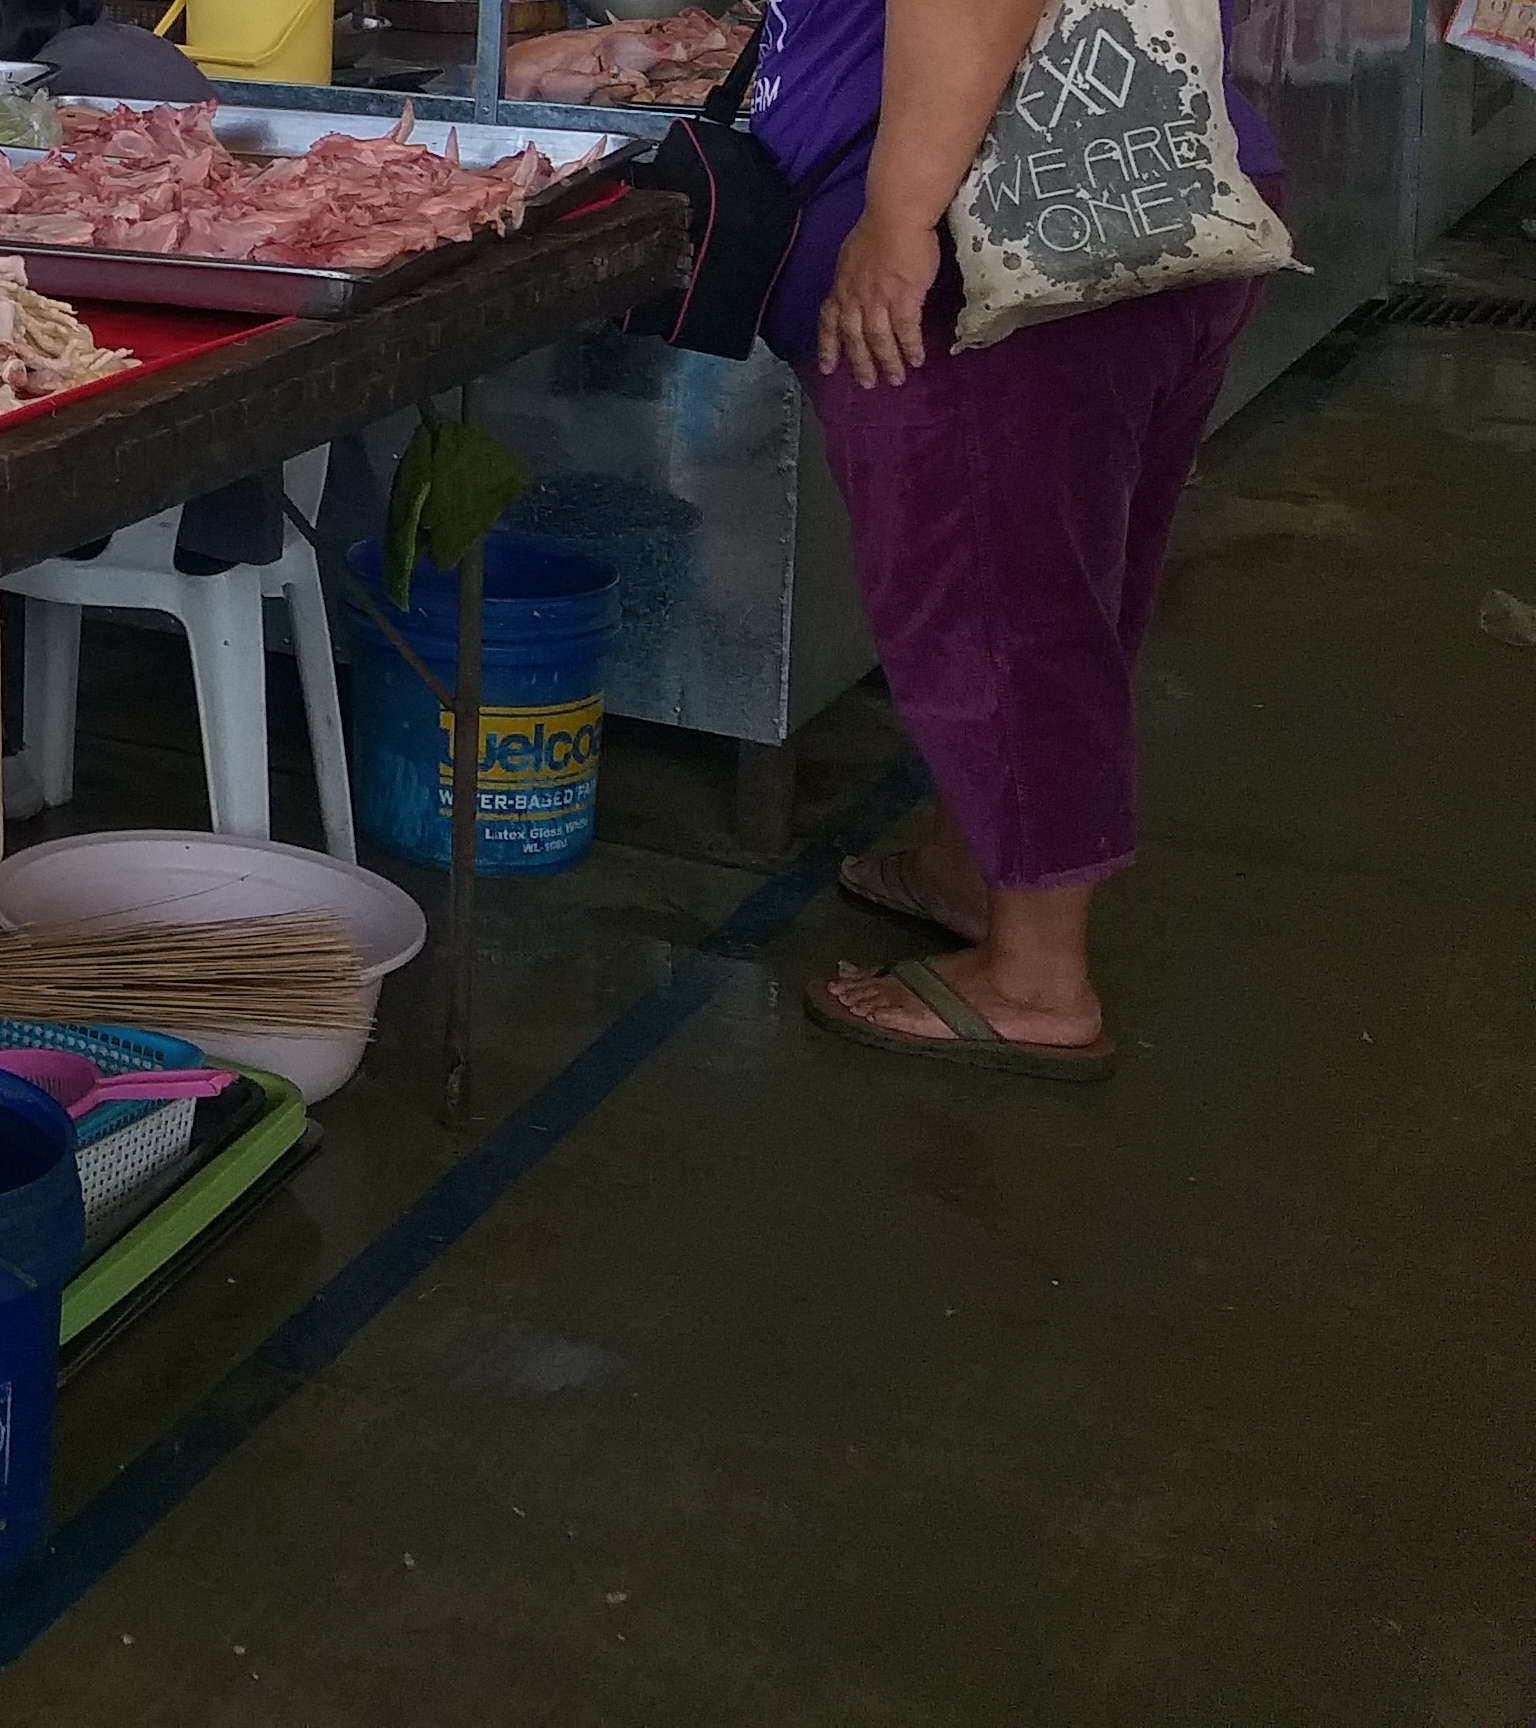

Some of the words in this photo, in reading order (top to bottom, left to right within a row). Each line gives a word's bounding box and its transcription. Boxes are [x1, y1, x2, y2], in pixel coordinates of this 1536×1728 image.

[1015, 27, 1137, 129] EXO
[981, 147, 1075, 213] WE
[1083, 118, 1208, 190] ARE
[1038, 181, 1184, 252] ONE
[439, 788, 574, 811] WER-BASED
[484, 827, 526, 842] Latex
[529, 825, 563, 841] Gloss
